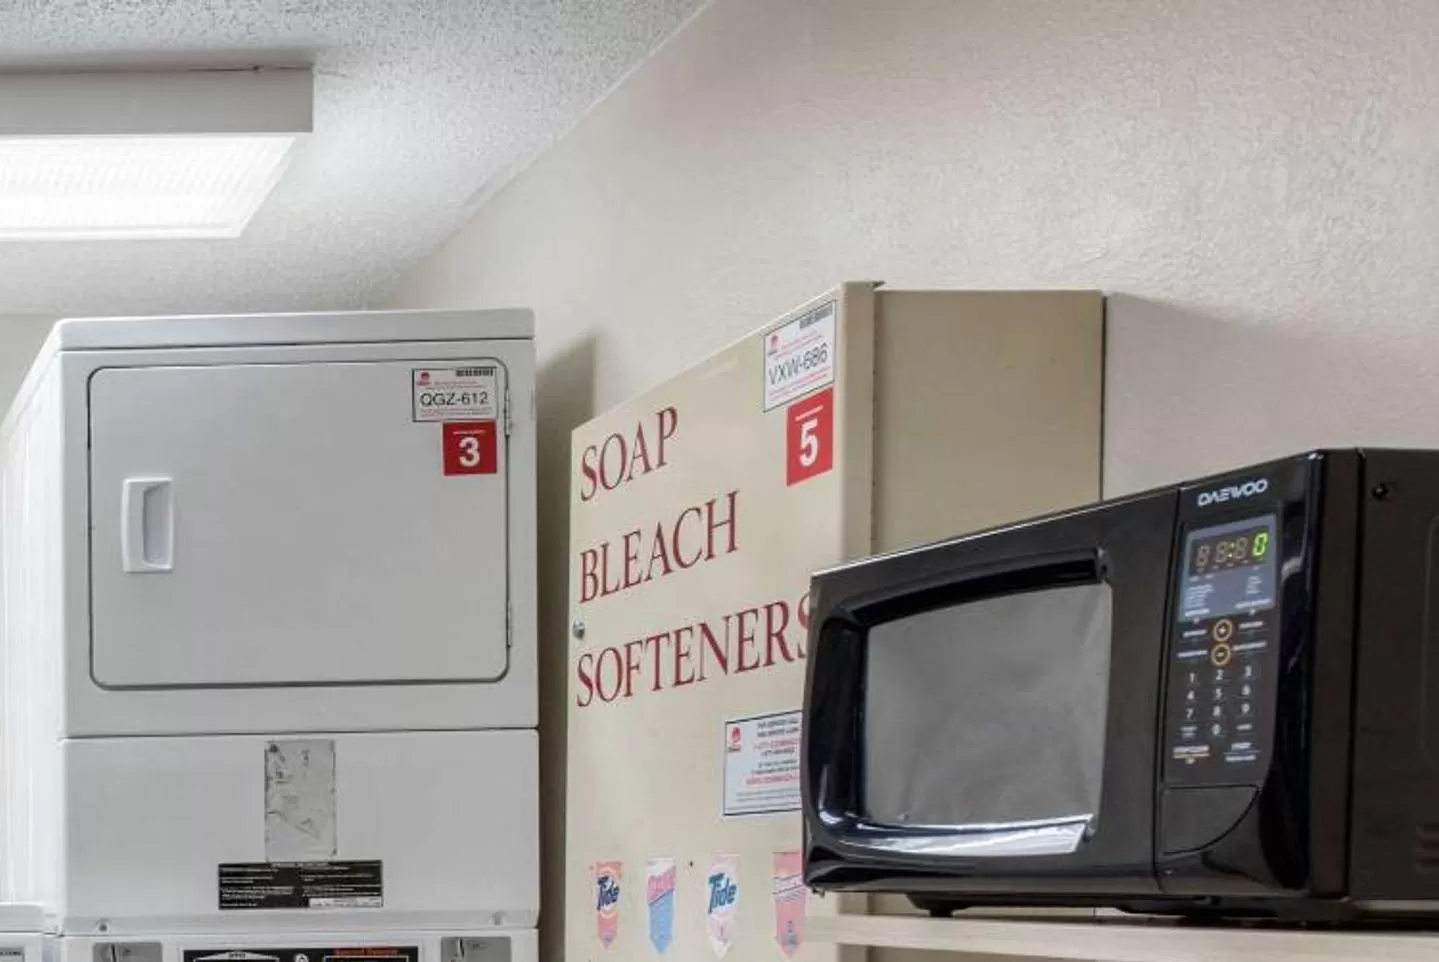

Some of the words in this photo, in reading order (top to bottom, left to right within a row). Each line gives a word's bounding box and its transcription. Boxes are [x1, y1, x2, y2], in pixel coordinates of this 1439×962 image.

[420, 391, 489, 407] QGZ-612
[459, 437, 480, 467] 3
[580, 406, 678, 502] SOAP
[799, 417, 819, 467] 5
[1197, 478, 1269, 506] DAEWOO
[579, 490, 740, 603] BLEACH
[596, 875, 621, 911] Tide
[707, 873, 737, 915] Tide
